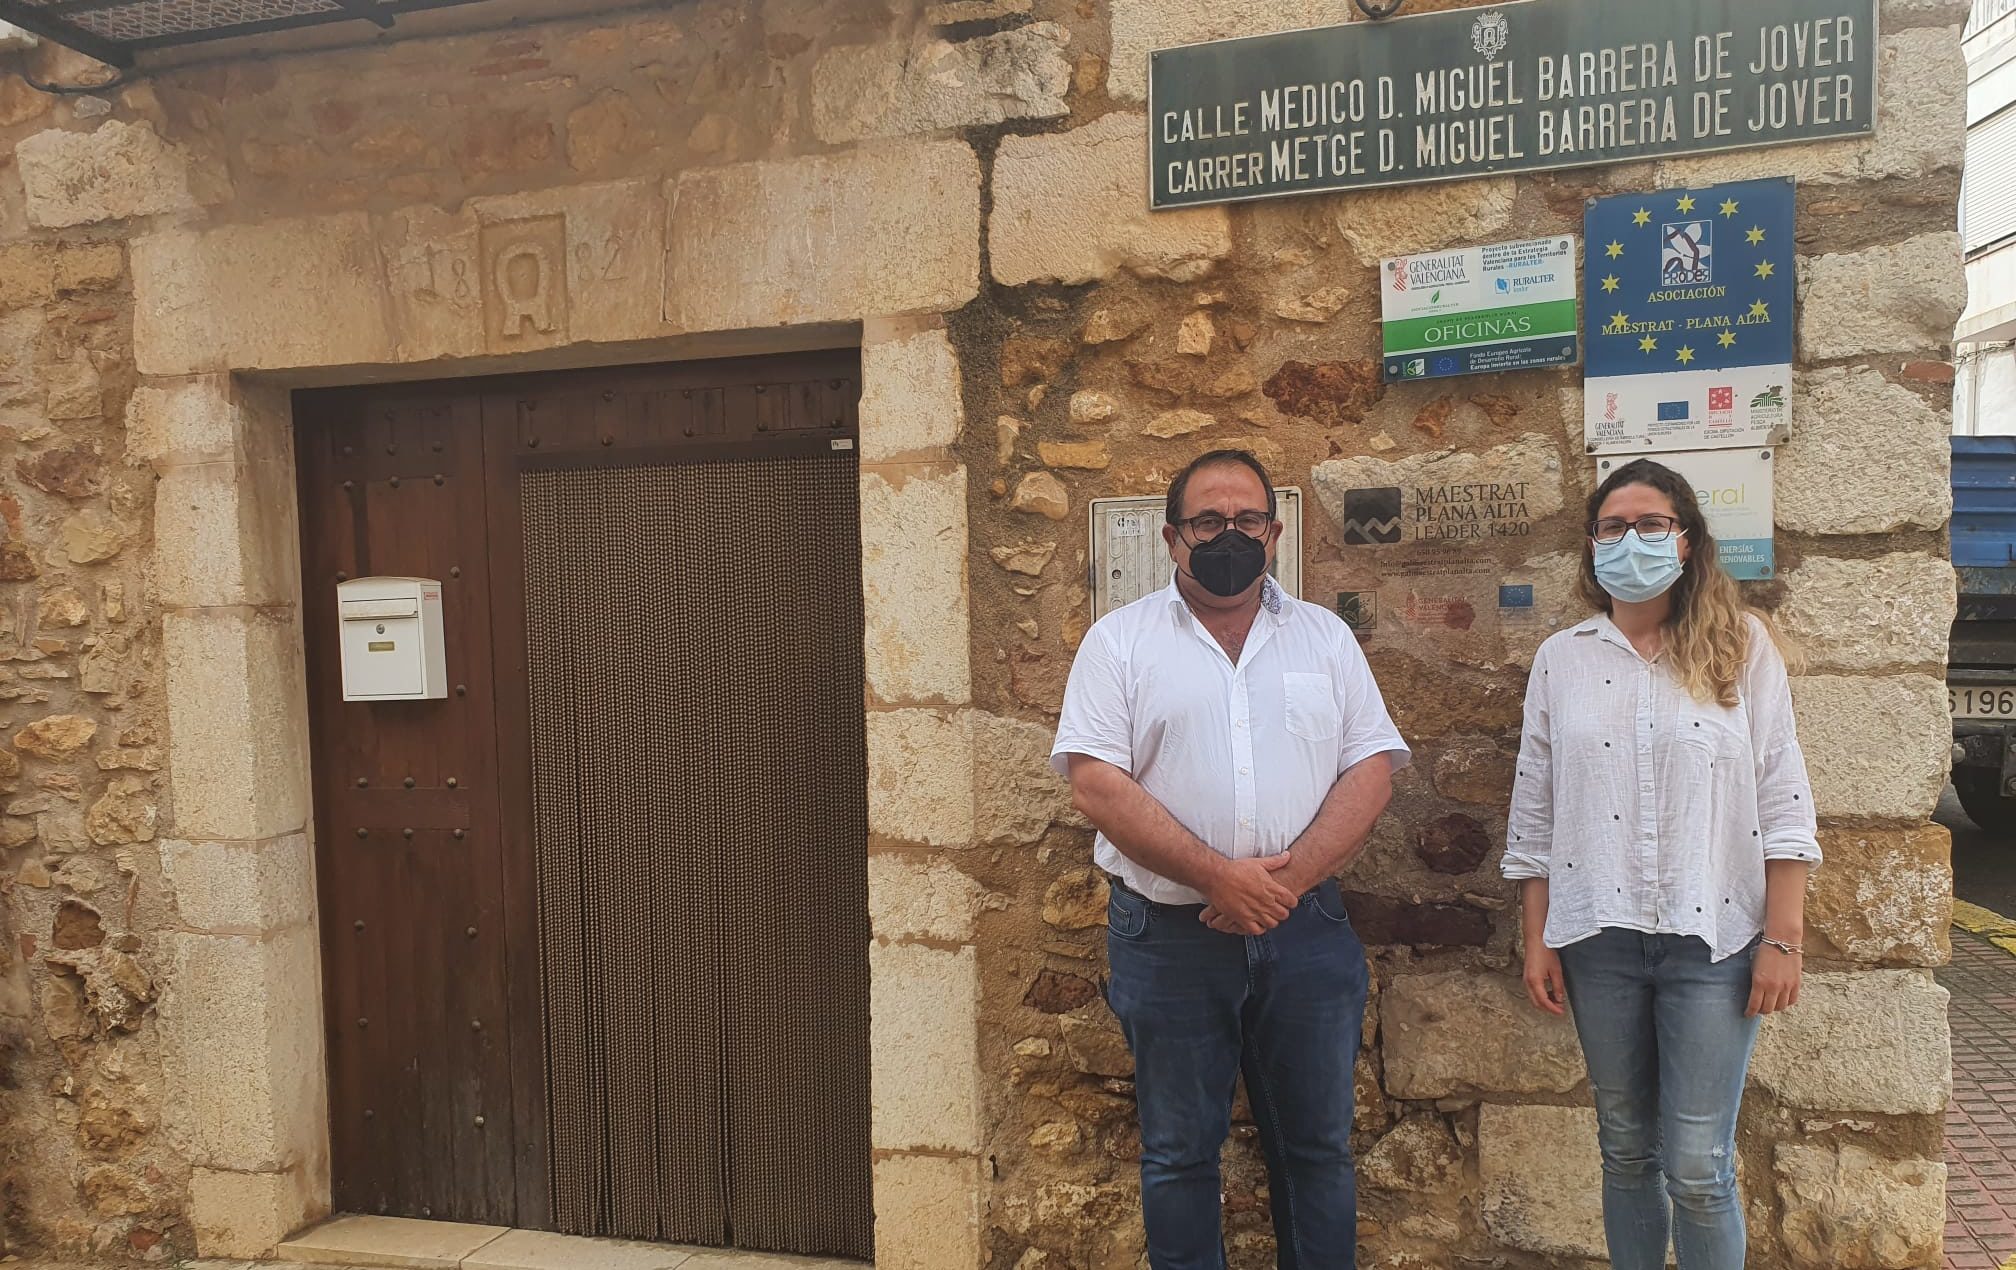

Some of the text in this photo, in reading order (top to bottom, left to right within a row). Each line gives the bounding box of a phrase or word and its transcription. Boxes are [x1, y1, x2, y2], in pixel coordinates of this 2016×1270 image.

[1163, 15, 1854, 144] CALLE MEDICO D. MIGUEL BARRERA DE JOVER
[1168, 74, 1852, 195] CARRER METGE D. MIGUEL BARRERA DE JOVER
[1409, 255, 1465, 273] GENERALITAT
[1410, 268, 1466, 285] VALENCIANA
[1512, 273, 1555, 287] RURALTER
[1647, 284, 1727, 302] ASOCIACIÓN
[1424, 316, 1531, 343] OFICINAS
[1602, 319, 1675, 335] MAESTRAT
[1686, 315, 1732, 329] PLANA
[1736, 313, 1771, 326] ALTA
[1416, 482, 1530, 504] MAESTRAT
[1416, 502, 1529, 522] PLANA ALTA
[1415, 521, 1529, 541] LEADER 1420
[1719, 544, 1755, 554] ENERGÍAS
[1719, 555, 1766, 565] RENOVABLES
